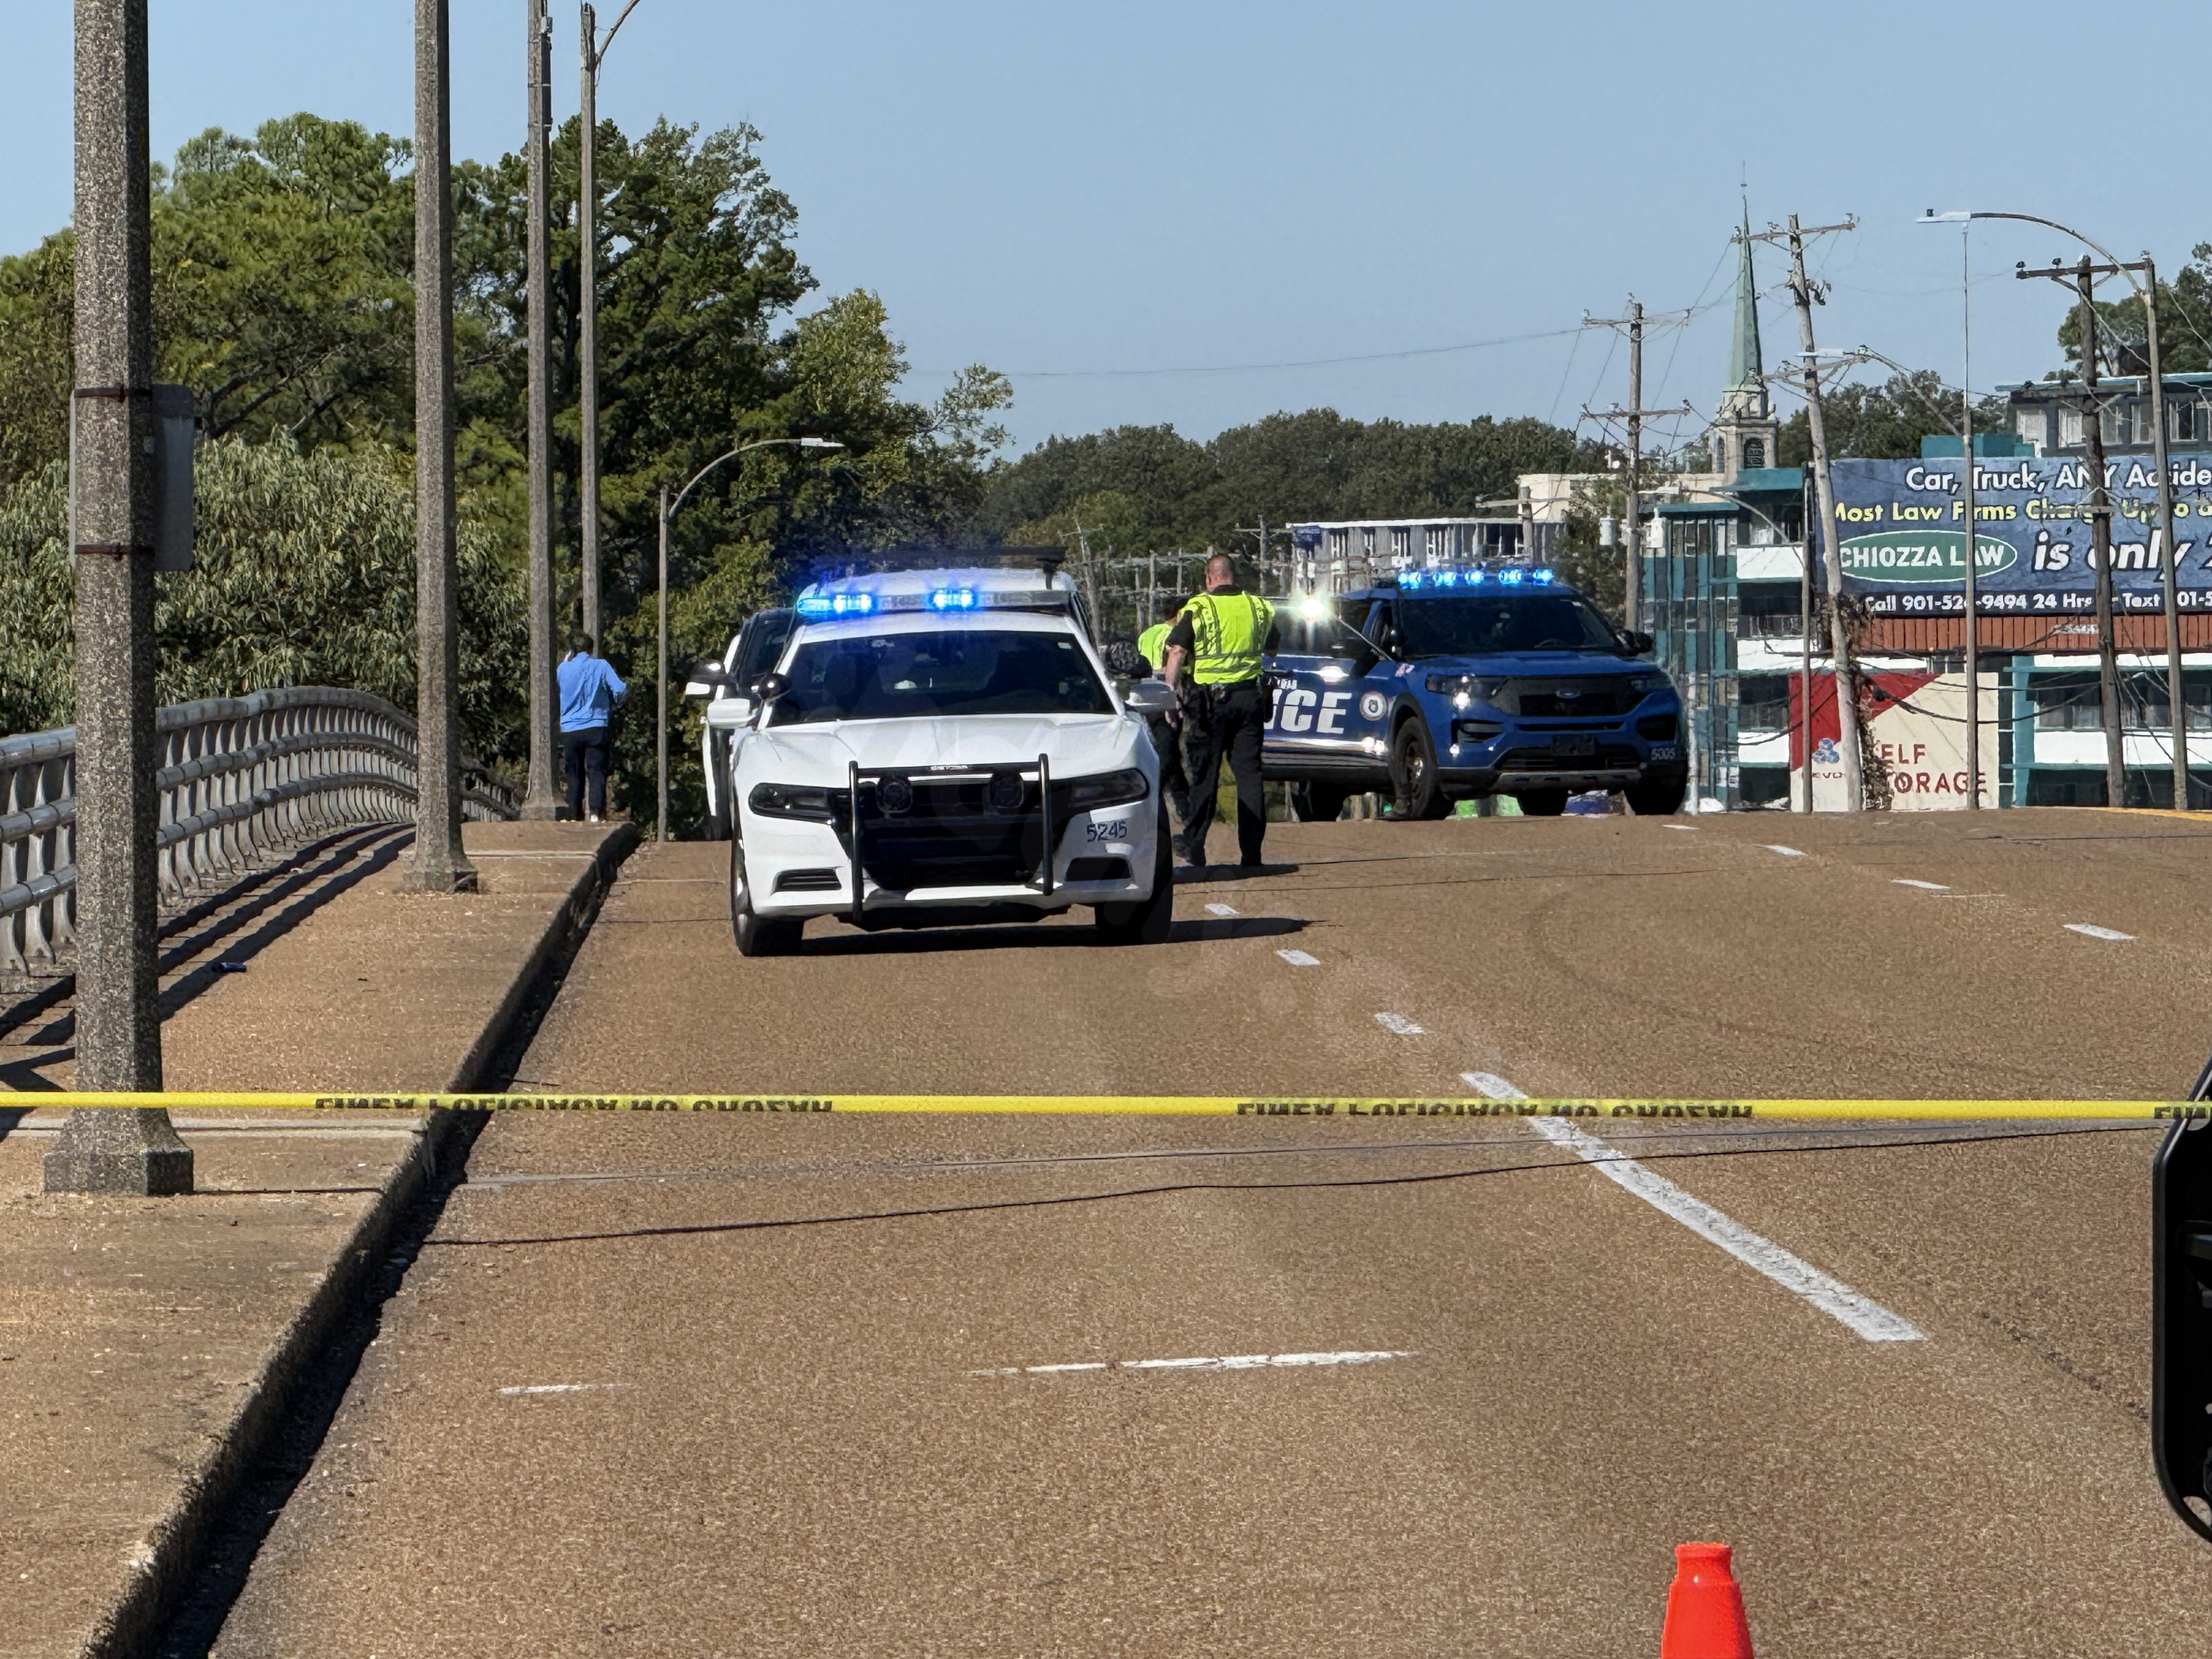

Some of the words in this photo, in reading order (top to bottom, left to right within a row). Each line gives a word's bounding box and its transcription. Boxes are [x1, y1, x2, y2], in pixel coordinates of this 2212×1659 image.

[1906, 466, 1959, 494] Car,
[2125, 460, 2211, 487] Acide
[1893, 502, 1943, 521] Law
[1952, 501, 2017, 520] Frms
[1840, 545, 1943, 567] CHIOZZA
[2034, 531, 2070, 570] is
[1866, 595, 1897, 612] Call
[1902, 594, 2027, 611] 901-52-9494
[2033, 593, 2057, 609] 24
[2123, 592, 2160, 607] Text
[2177, 591, 2212, 607] 01-5
[1263, 689, 1352, 734] ICE
[1881, 743, 1926, 764] ELF
[1887, 771, 1988, 795] ORAGE
[1087, 821, 1127, 842] 5245
